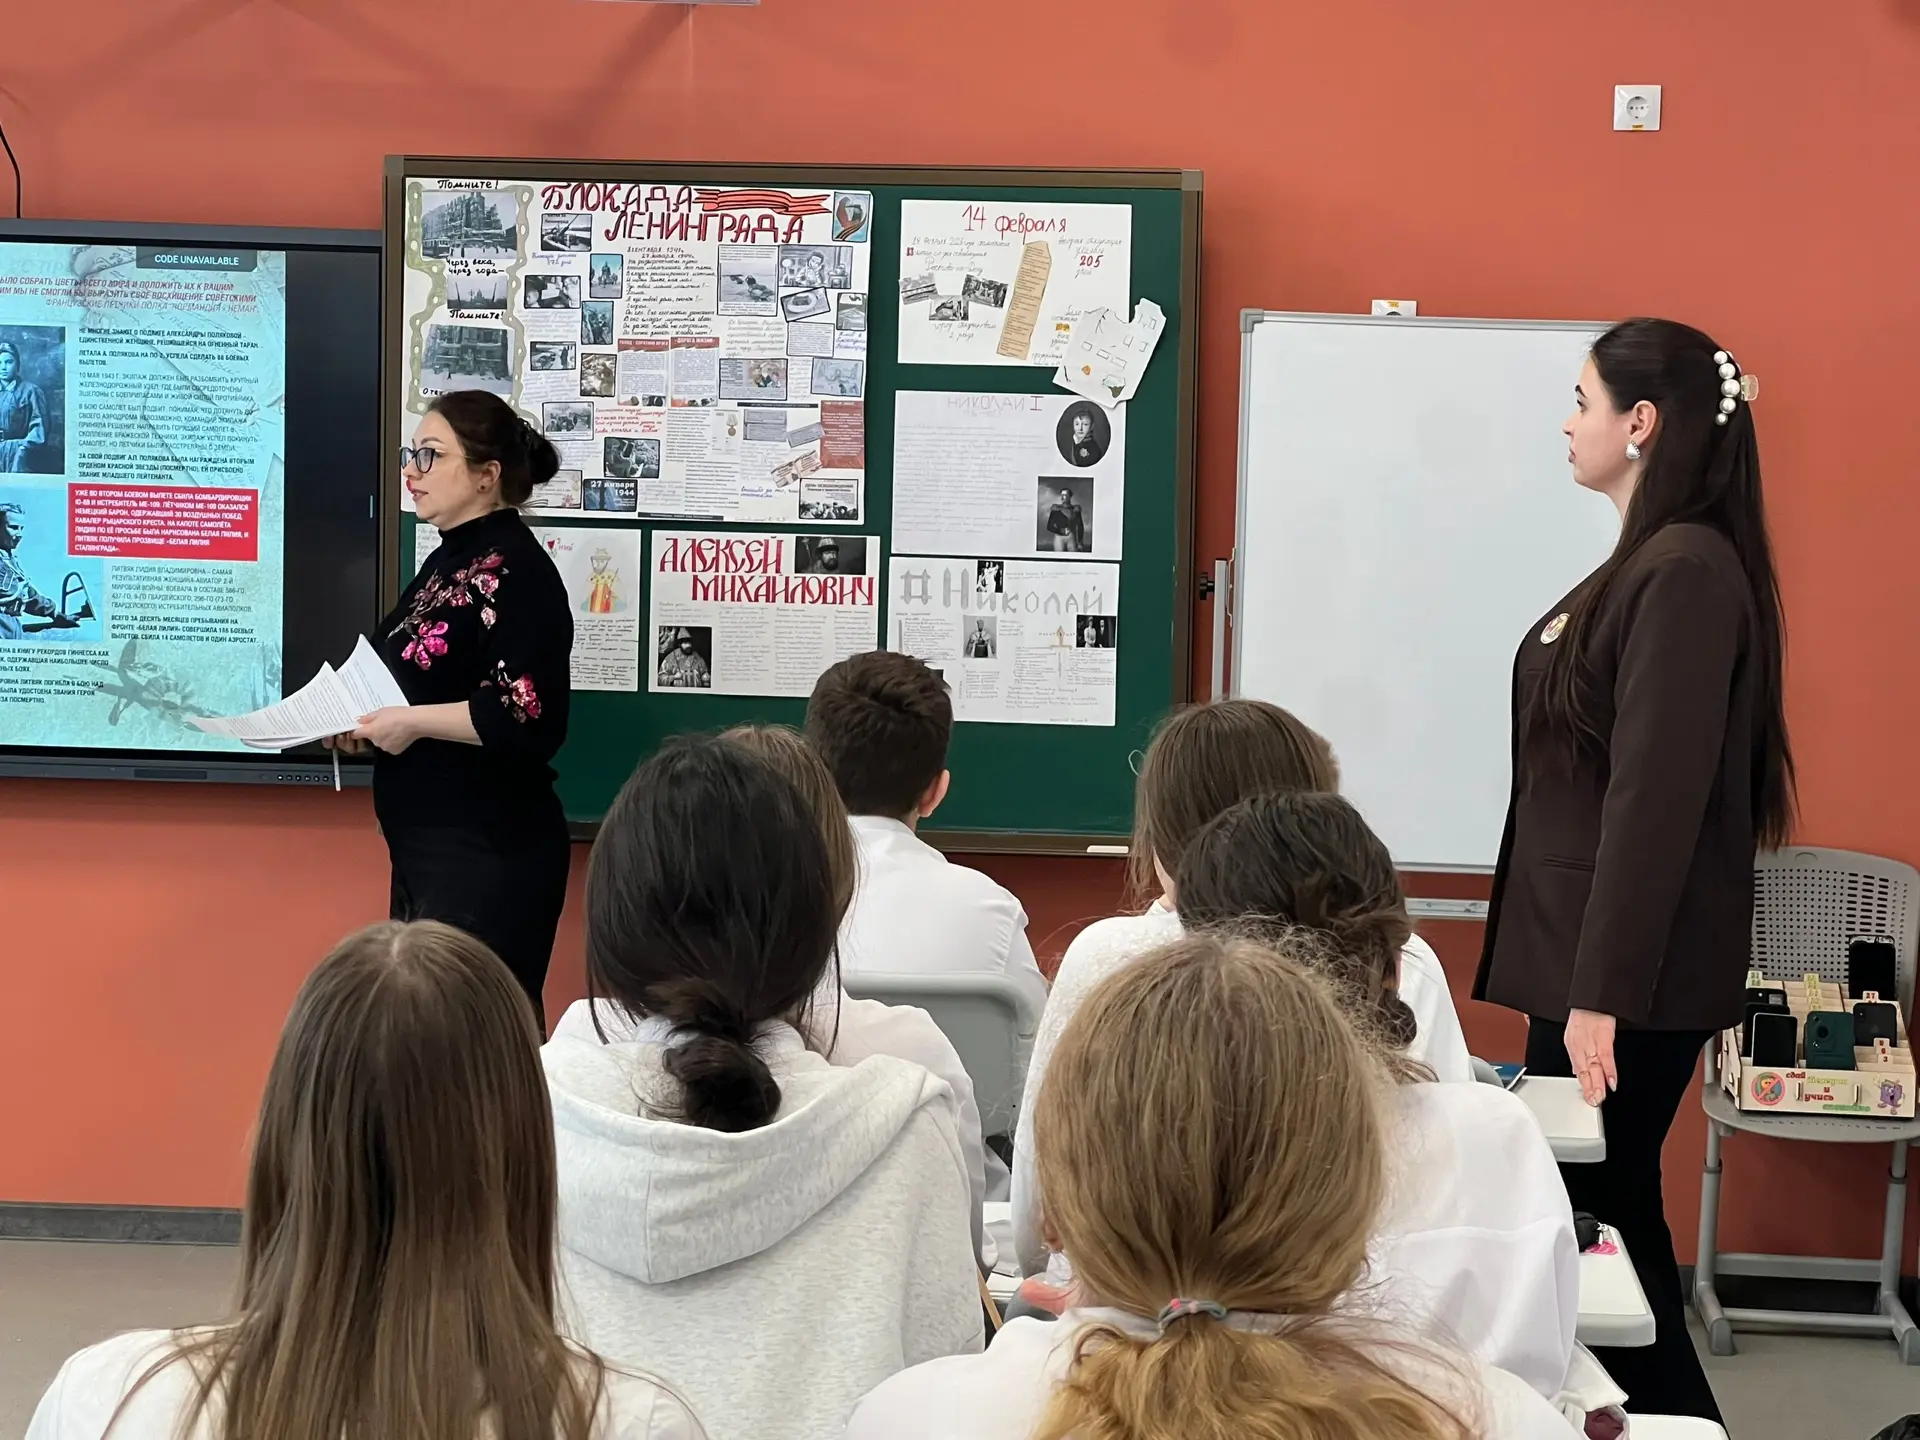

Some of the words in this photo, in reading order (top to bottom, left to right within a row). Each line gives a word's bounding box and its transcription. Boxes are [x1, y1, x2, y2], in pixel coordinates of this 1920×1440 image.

[437, 180, 499, 192] Помните!
[541, 182, 692, 212] БЛОКАДА
[604, 212, 804, 243] ЛЕНИНГРАДА
[962, 204, 987, 231] 14
[994, 212, 1068, 245] февраля
[154, 255, 178, 264] CODE
[180, 256, 239, 266] UNAVAILABLE
[473, 258, 495, 267] века,
[1080, 255, 1104, 268] 205
[20, 278, 52, 286] СОБРАТЬ
[140, 281, 181, 290] ПОЛОЖИТЬ
[184, 282, 194, 290] ИХ
[196, 282, 201, 290] К
[204, 282, 234, 291] ВАШИМ
[14, 287, 28, 295] МЫ
[29, 288, 38, 296] НЕ
[41, 288, 71, 297] СМОГЛИ
[152, 291, 203, 302] ВОСХИЩЕНИЕ
[206, 293, 256, 303] СОВЕТСКИМИ
[450, 310, 504, 321] Помните!
[141, 351, 148, 359] НА
[79, 452, 86, 460] ЗА
[139, 454, 169, 462] ПОЛЯКОВА
[108, 462, 133, 470] КРАСНОЙ
[604, 481, 634, 489] января
[659, 535, 784, 574] АЛЕКСЕЙ
[692, 574, 874, 606] МИХАЙЛОВИЧ
[112, 614, 129, 622] ВСЕГО
[211, 636, 226, 644] ОДИН
